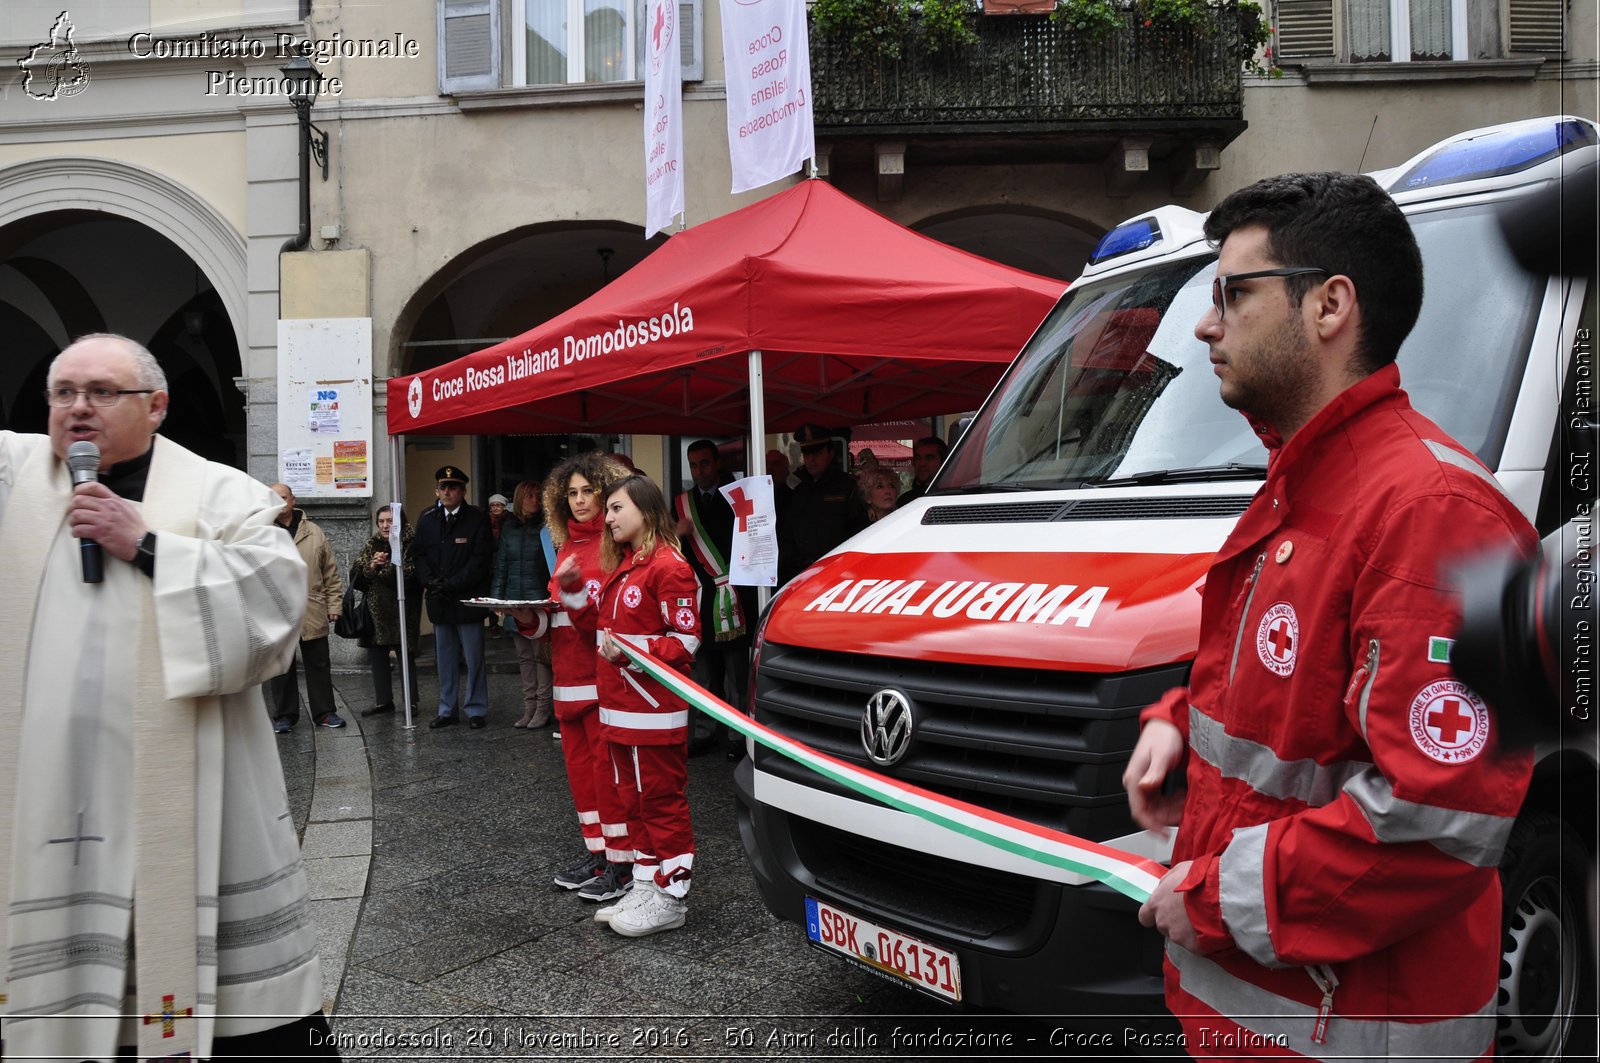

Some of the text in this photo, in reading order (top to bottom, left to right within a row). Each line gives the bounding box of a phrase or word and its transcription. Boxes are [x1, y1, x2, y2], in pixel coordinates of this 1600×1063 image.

[432, 377, 464, 402] Croce
[466, 364, 505, 393] Rossa
[507, 347, 559, 383] Italiana
[563, 302, 694, 365] Domodossola
[317, 390, 337, 400] NO
[1258, 617, 1273, 668] CONVENZIONE
[1412, 682, 1488, 760] CONVENZIONE DI GINEVRA 22 AGOSTO 1864
[810, 908, 955, 993] D SBK 06131
[845, 958, 913, 991] www.ambulanzmobile.eu
